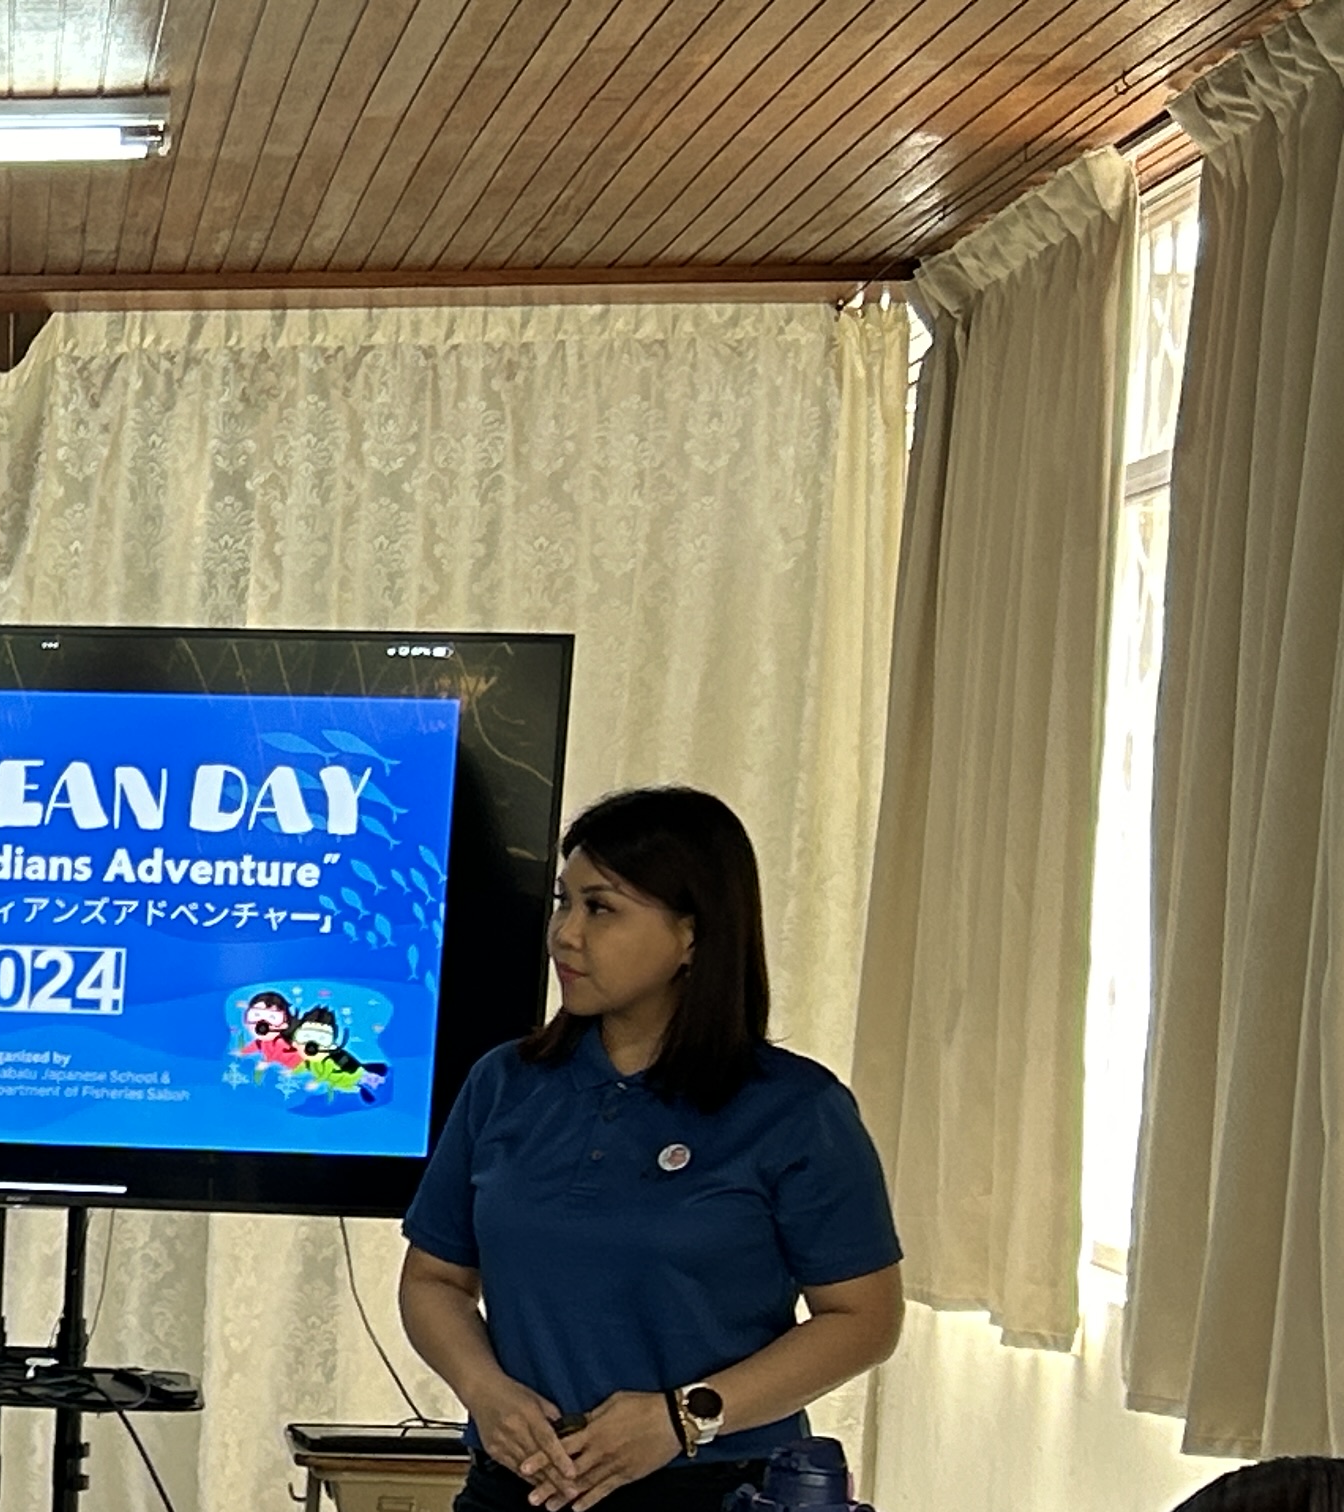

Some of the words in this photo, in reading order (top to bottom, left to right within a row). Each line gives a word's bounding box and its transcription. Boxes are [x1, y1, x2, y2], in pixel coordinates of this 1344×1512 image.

[189, 764, 372, 836] DAY
[52, 1051, 72, 1068] by
[41, 1067, 107, 1084] Japanese
[109, 1069, 158, 1084] School
